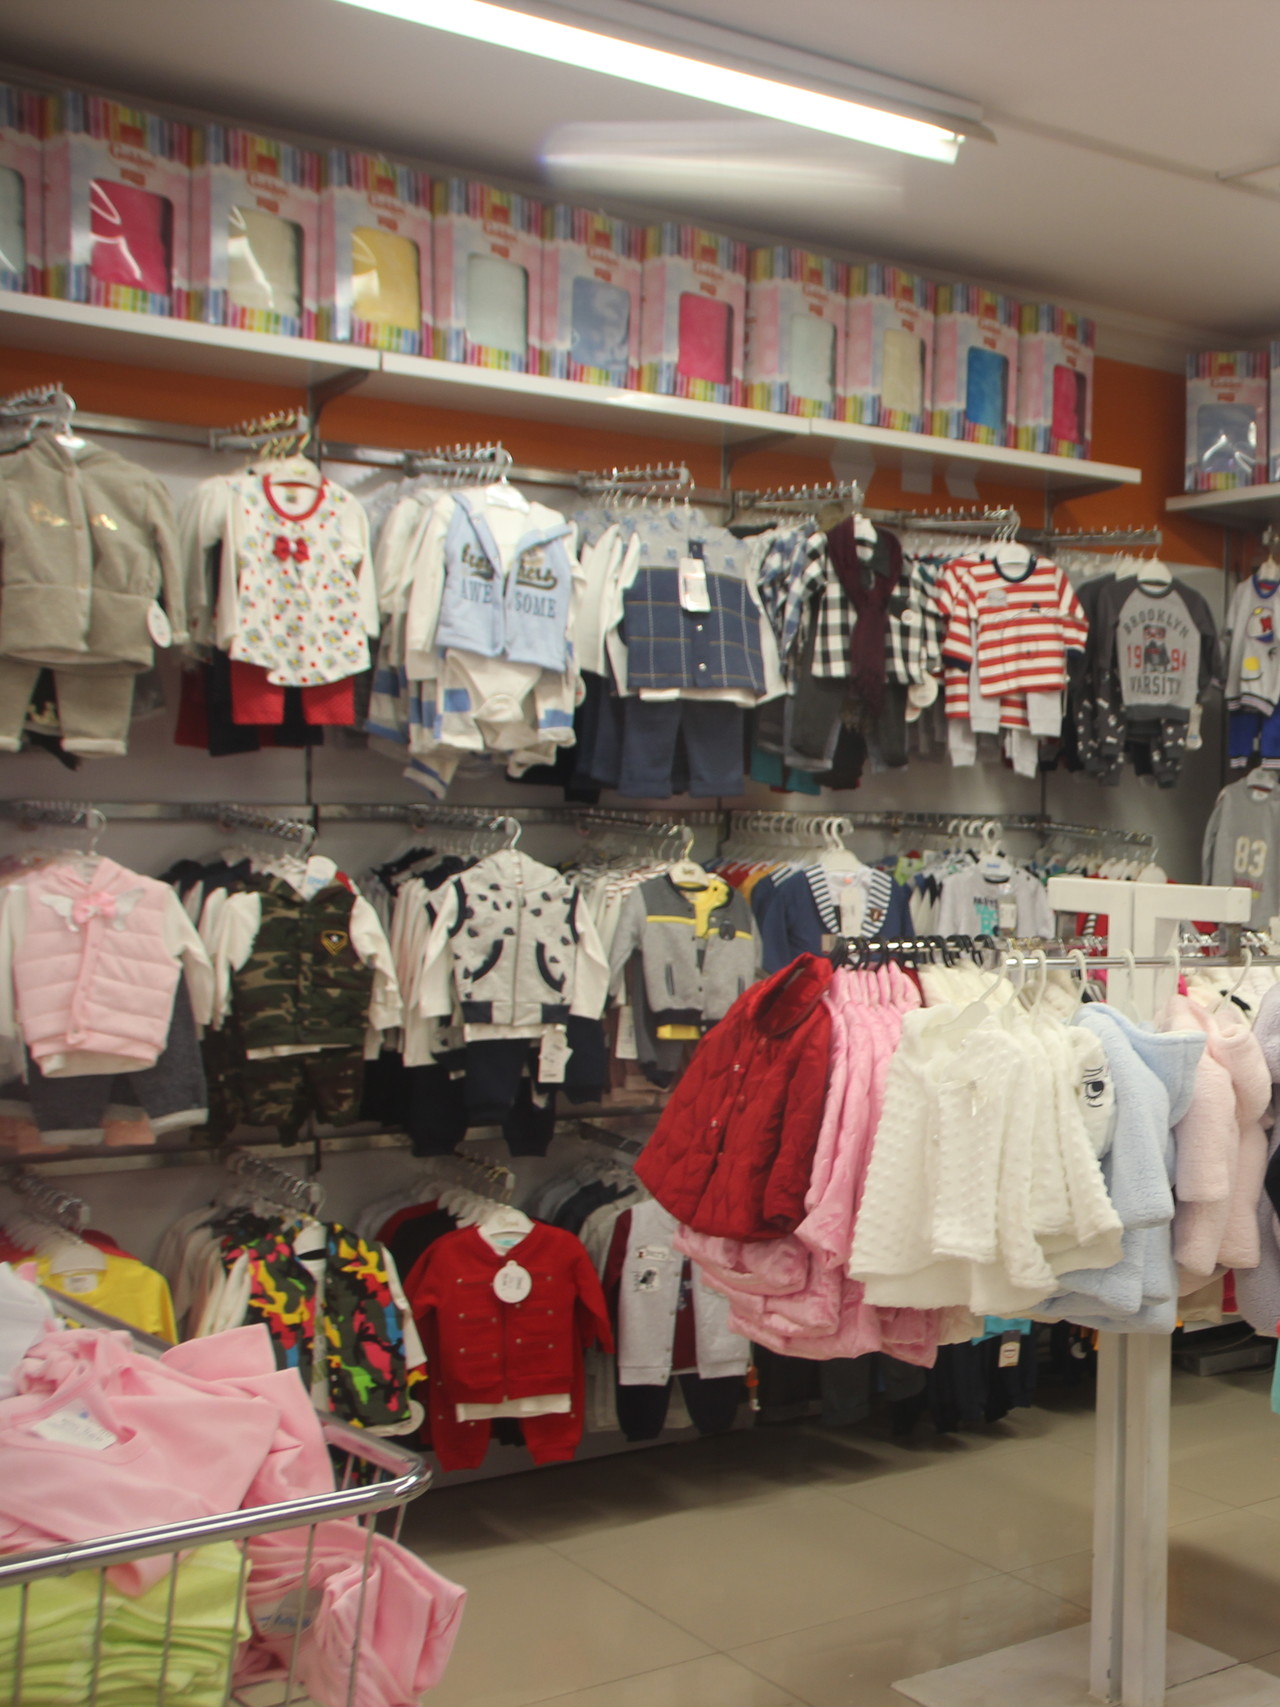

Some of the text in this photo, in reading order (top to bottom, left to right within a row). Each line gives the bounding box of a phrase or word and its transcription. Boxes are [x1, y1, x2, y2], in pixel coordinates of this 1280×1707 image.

[514, 590, 556, 618] SOME
[1123, 607, 1190, 639] BROOKLYN
[1130, 675, 1183, 696] VARSITY
[1233, 835, 1268, 878] 83
